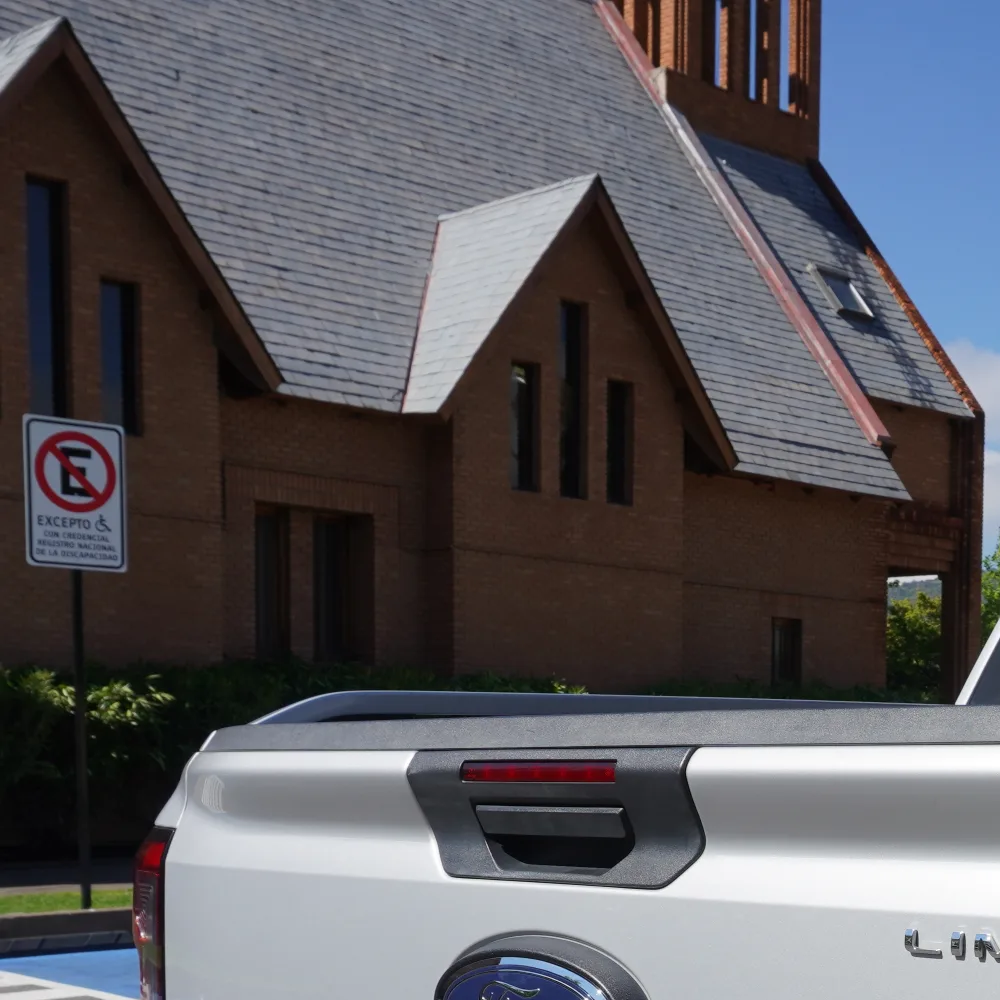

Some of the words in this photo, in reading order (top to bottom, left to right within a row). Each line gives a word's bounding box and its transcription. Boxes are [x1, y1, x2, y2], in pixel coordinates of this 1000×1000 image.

[37, 514, 91, 530] EXCEPTO
[43, 530, 59, 538] CON
[62, 532, 110, 543] CREDENCIAL
[38, 540, 75, 549] REGISTRO
[78, 543, 117, 552] NACIONAL
[36, 548, 46, 556] DE
[48, 549, 58, 557] LA
[62, 551, 119, 561] DISCAPACIDAD
